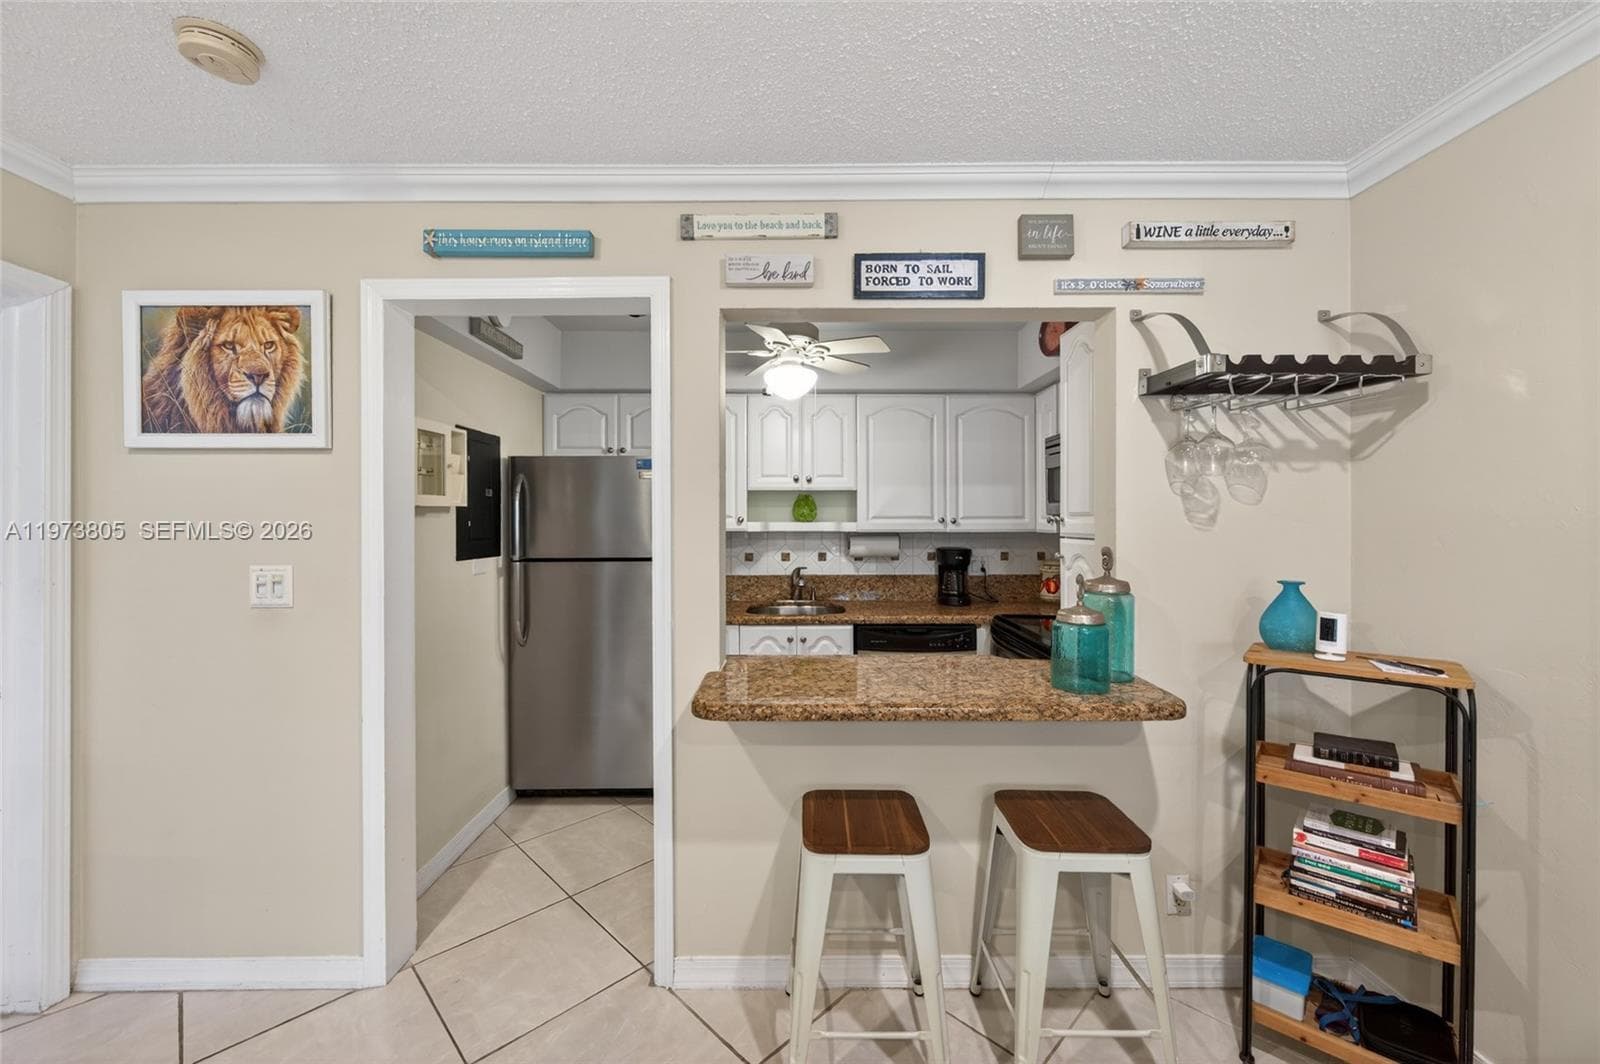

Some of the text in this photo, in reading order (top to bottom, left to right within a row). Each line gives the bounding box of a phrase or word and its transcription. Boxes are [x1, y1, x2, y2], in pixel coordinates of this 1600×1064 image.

[745, 221, 758, 230] the
[760, 221, 784, 230] beach
[785, 221, 800, 230] and
[1143, 225, 1183, 238] WINE
[1185, 228, 1193, 237] a
[1195, 225, 1219, 237] little
[865, 264, 953, 274] BORN TO SAIL
[865, 276, 973, 286] FORCED TO WORK
[1144, 279, 1200, 289] Somewhere
